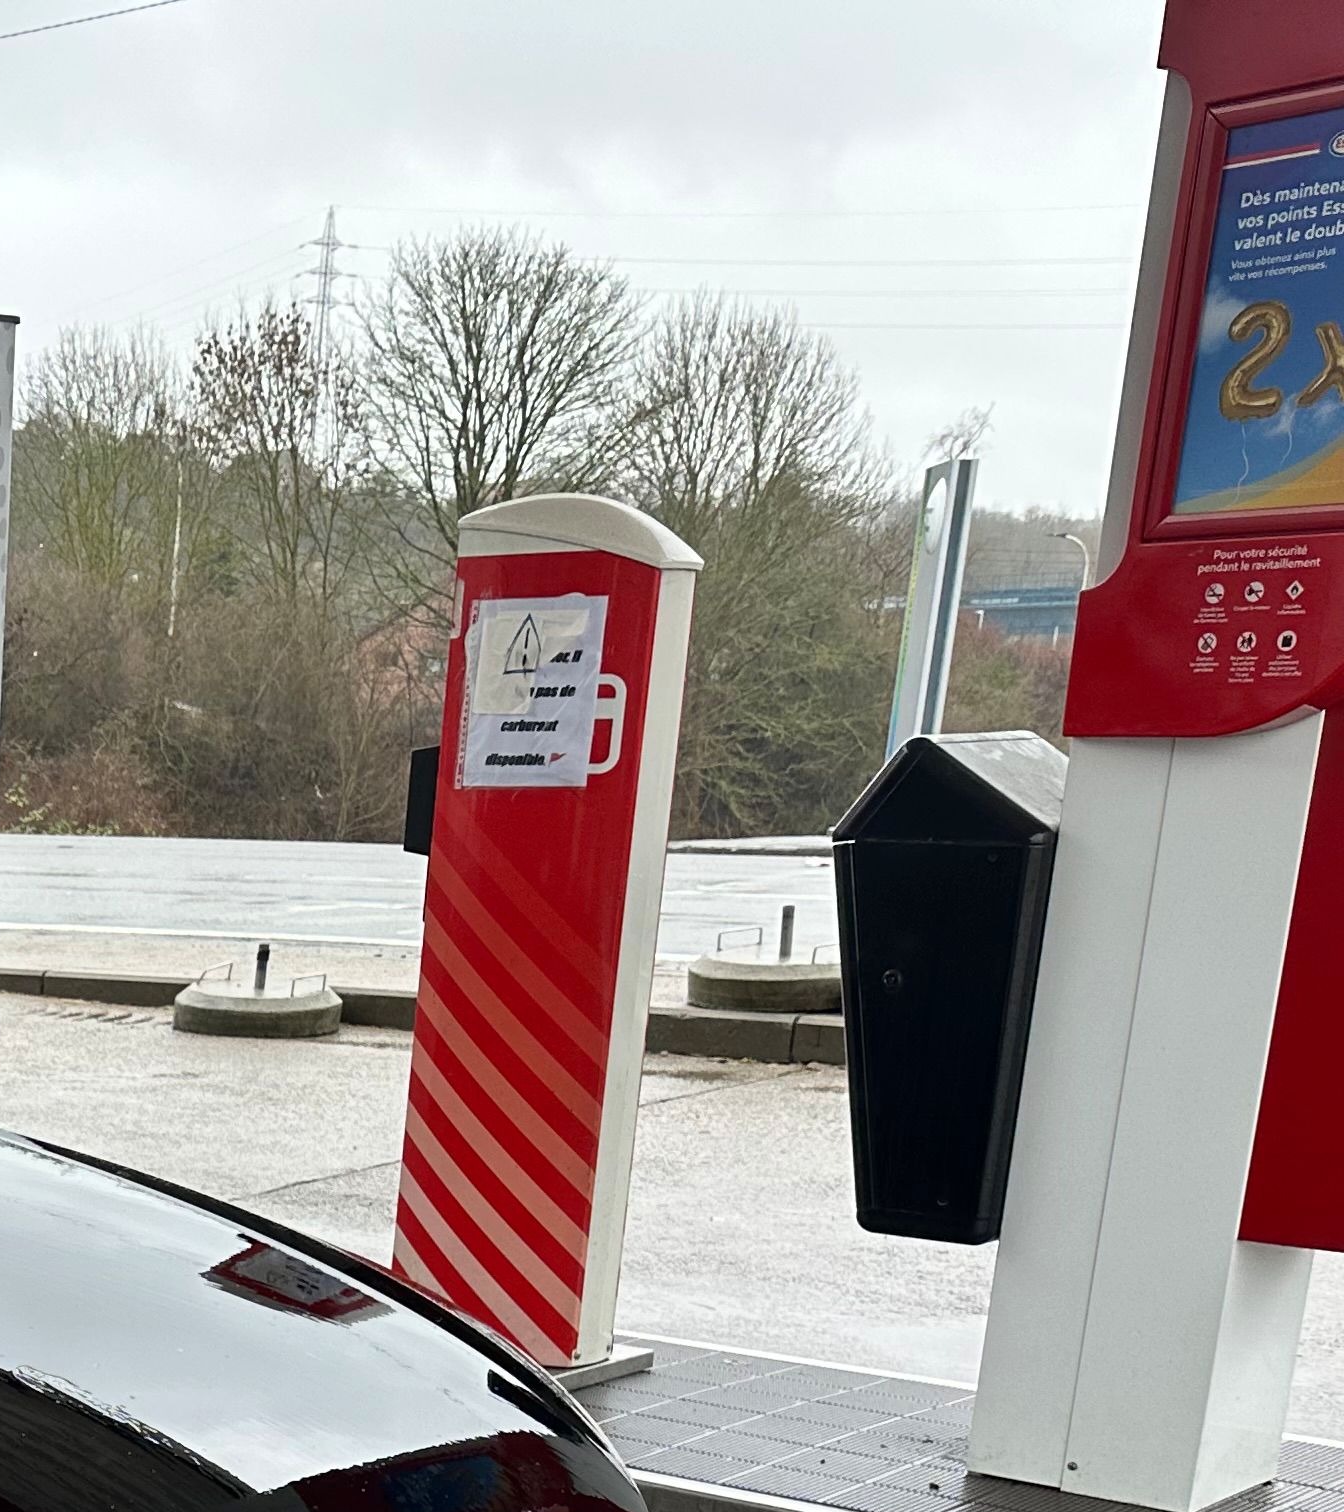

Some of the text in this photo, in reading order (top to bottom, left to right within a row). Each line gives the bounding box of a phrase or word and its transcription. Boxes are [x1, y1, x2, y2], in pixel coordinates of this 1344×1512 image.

[1240, 190, 1271, 208] Dès
[1237, 216, 1264, 229] vos
[1267, 205, 1317, 229] points
[1234, 231, 1282, 250] valent
[1286, 227, 1300, 243] le
[1316, 246, 1337, 259] plus
[1213, 544, 1308, 560] Pour votre sécurité
[1197, 557, 1321, 576] pendant le ravitaillement
[534, 686, 559, 699] pas
[559, 684, 576, 697] de
[500, 719, 559, 732] carburant
